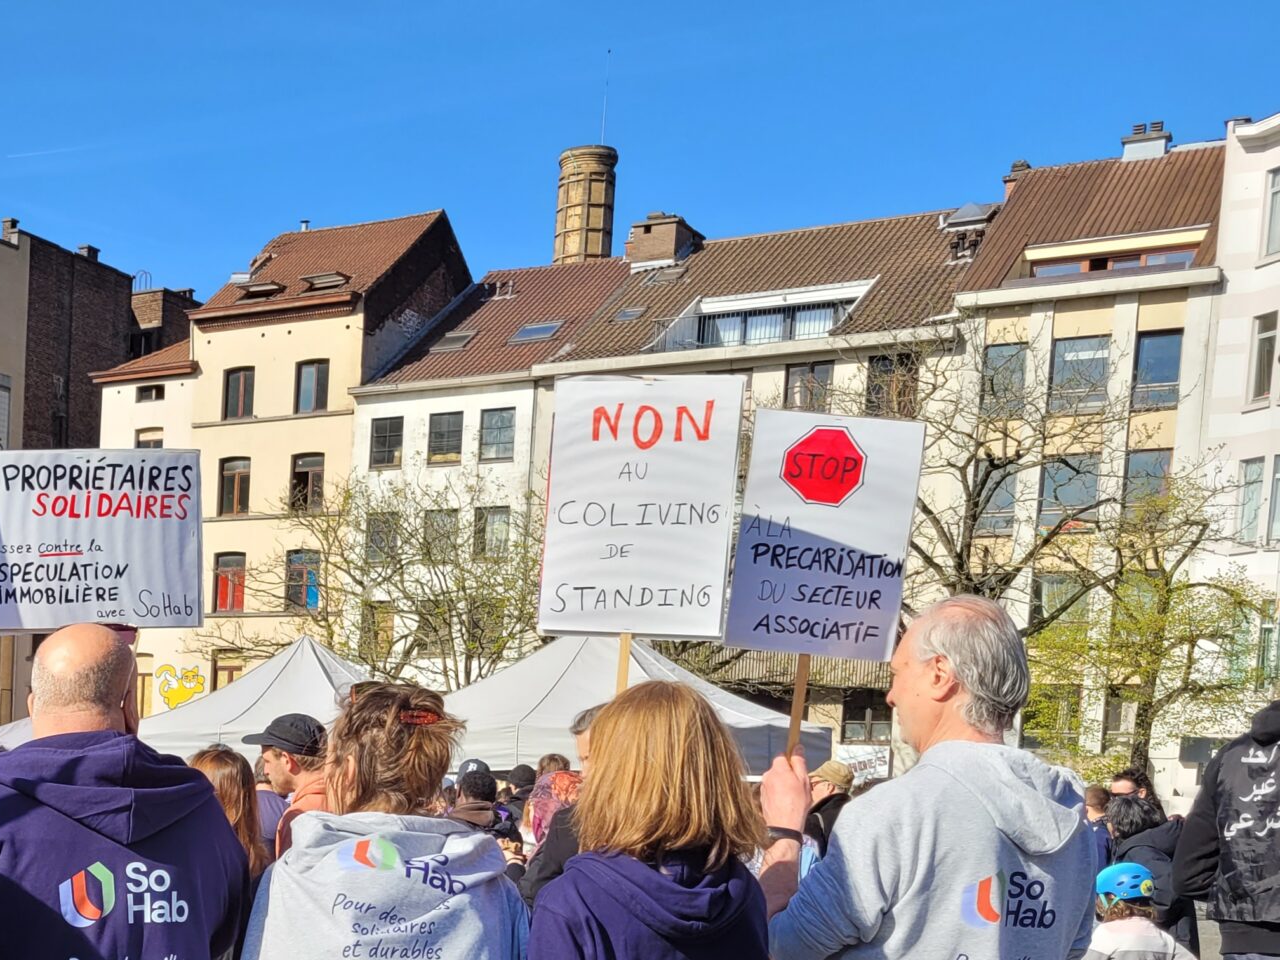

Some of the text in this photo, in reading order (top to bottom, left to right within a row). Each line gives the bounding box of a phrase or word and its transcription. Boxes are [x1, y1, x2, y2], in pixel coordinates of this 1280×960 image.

[592, 399, 715, 450] NON
[618, 461, 648, 482] AU
[788, 453, 859, 484] STOP
[557, 500, 721, 527] COLIVING
[766, 514, 793, 539] LA
[38, 539, 83, 555] contre
[86, 538, 104, 553] la
[599, 543, 634, 560] DE
[550, 583, 712, 613] STANDING
[757, 580, 882, 610] DU SECTEUR
[96, 609, 126, 619] avec
[125, 862, 171, 893] So
[1008, 871, 1044, 900] So
[127, 891, 189, 924] Hab
[332, 893, 376, 915] Pour
[1005, 900, 1056, 929] Hab
[342, 938, 443, 960] et durables
